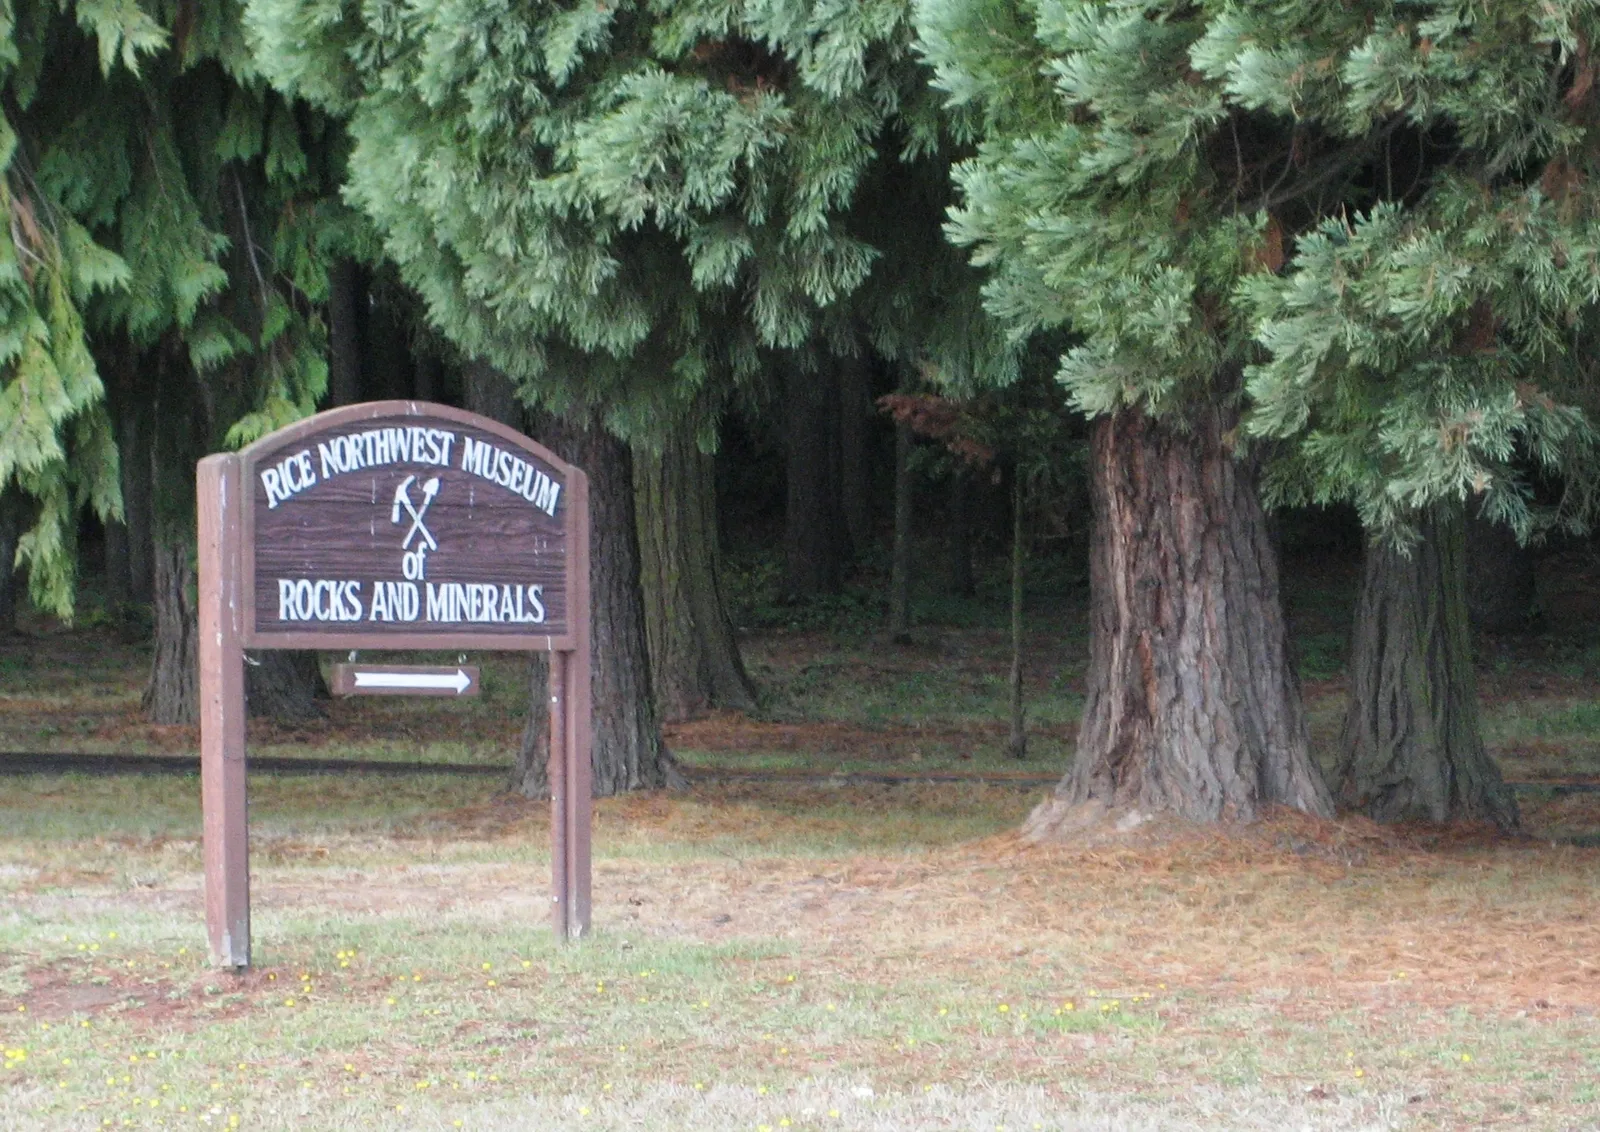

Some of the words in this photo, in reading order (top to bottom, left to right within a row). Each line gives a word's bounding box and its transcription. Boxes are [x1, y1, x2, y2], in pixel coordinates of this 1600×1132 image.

[261, 450, 317, 509] RICE
[318, 427, 455, 479] NORTHWEST
[461, 436, 561, 517] MUSEUM
[402, 542, 427, 580] of
[278, 579, 362, 621] ROCKS
[369, 581, 419, 622] AND
[426, 583, 545, 623] MINERALS
